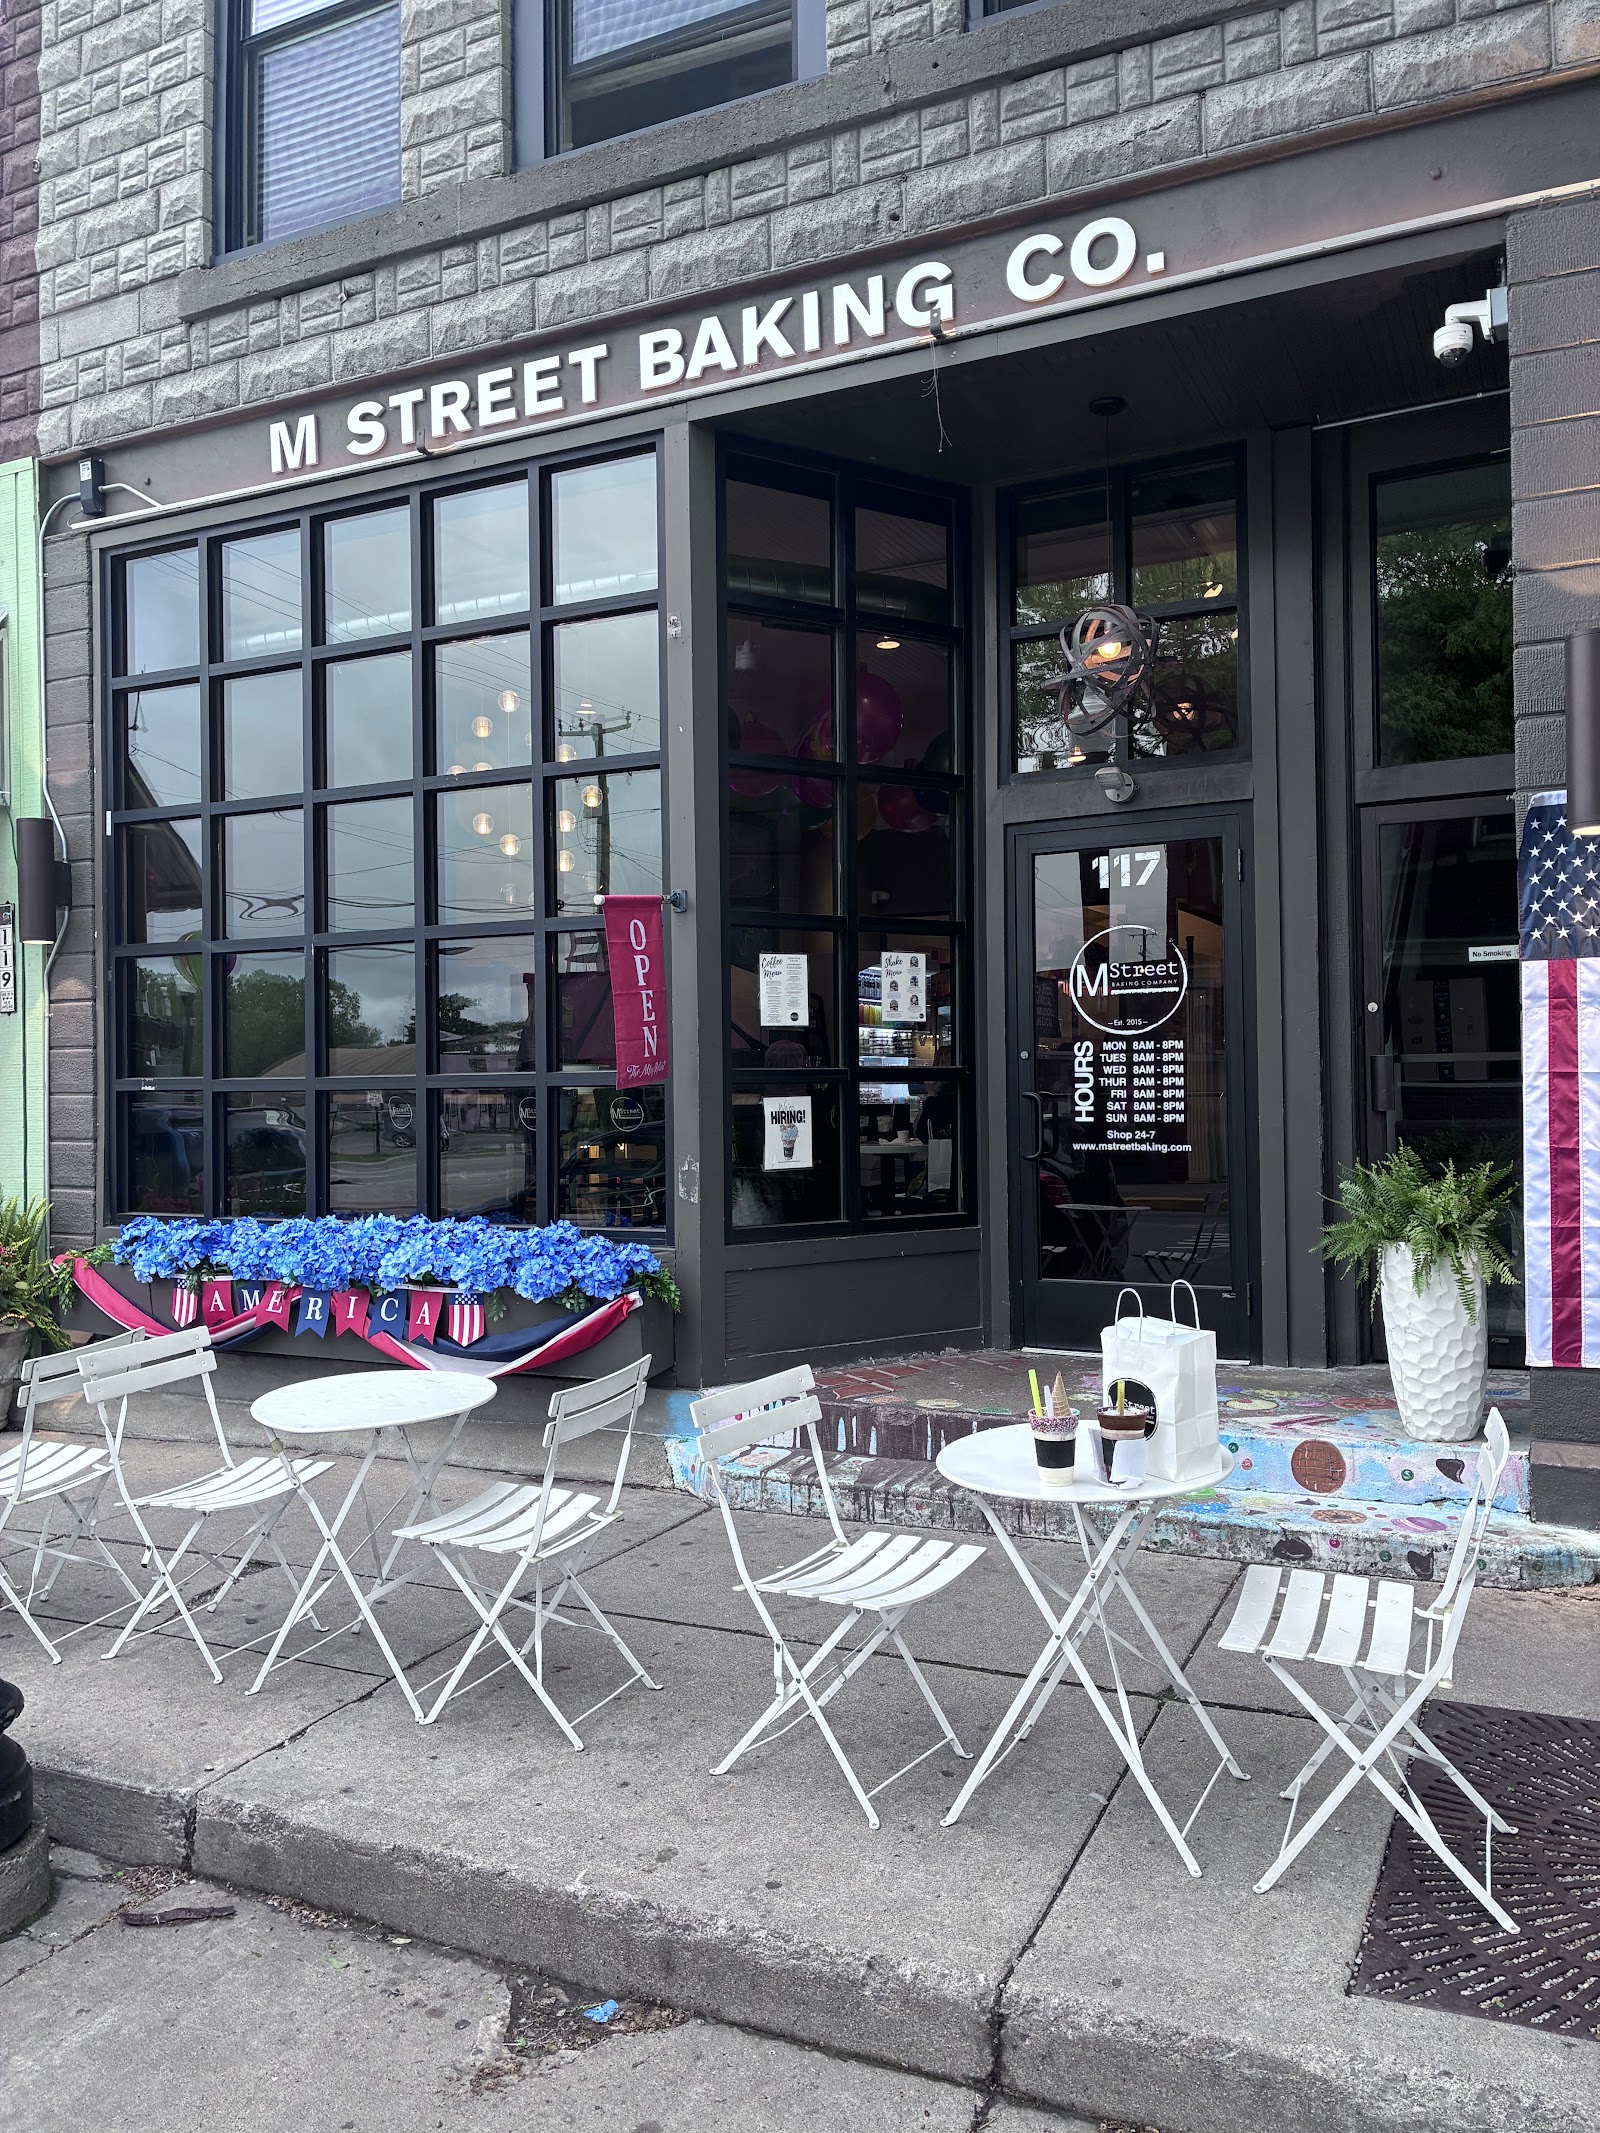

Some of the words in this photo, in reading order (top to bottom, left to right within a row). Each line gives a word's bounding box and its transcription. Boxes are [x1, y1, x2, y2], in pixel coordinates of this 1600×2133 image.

[269, 414, 319, 473] M
[346, 345, 608, 455] STREET
[639, 261, 954, 390] BAKING
[1006, 217, 1166, 302] CO.
[1092, 850, 1160, 889] 117
[1483, 949, 1512, 957] Smoking
[761, 956, 783, 969] Coffee
[884, 954, 904, 969] Shake
[763, 969, 782, 980] Menu
[885, 968, 902, 979] Menu
[1076, 963, 1108, 997] M
[1109, 961, 1179, 978] Street
[629, 919, 657, 1058] OPEN
[1102, 1041, 1127, 1050] MON
[1132, 1041, 1154, 1050] 8AM
[1162, 1040, 1184, 1049] 8PM
[1099, 1053, 1127, 1062] TUES
[1132, 1053, 1154, 1062] 8AM
[1162, 1053, 1184, 1061] 8PM
[1103, 1066, 1127, 1074] WED
[1132, 1065, 1154, 1074] 8AM
[1162, 1065, 1184, 1073] 8PM
[1074, 1040, 1094, 1122] HOURS
[1098, 1077, 1127, 1086] THUR
[1133, 1077, 1155, 1086] 8AM
[1162, 1077, 1184, 1086] 8PM
[1110, 1089, 1127, 1098] FRI
[1133, 1089, 1155, 1098] 8AM
[1162, 1089, 1184, 1098] 8PM
[1106, 1101, 1127, 1110] SAT
[1133, 1101, 1155, 1110] 8AM
[1162, 1101, 1184, 1110] 8PM
[771, 1110, 806, 1125] HIRING!
[1105, 1113, 1127, 1122] SUN
[1133, 1113, 1155, 1122] 8AM
[1162, 1113, 1184, 1122] 8PM
[1106, 1130, 1132, 1141] Shop
[1134, 1131, 1156, 1139] 24-7
[1072, 1142, 1192, 1153] www.mstreetbaking.com
